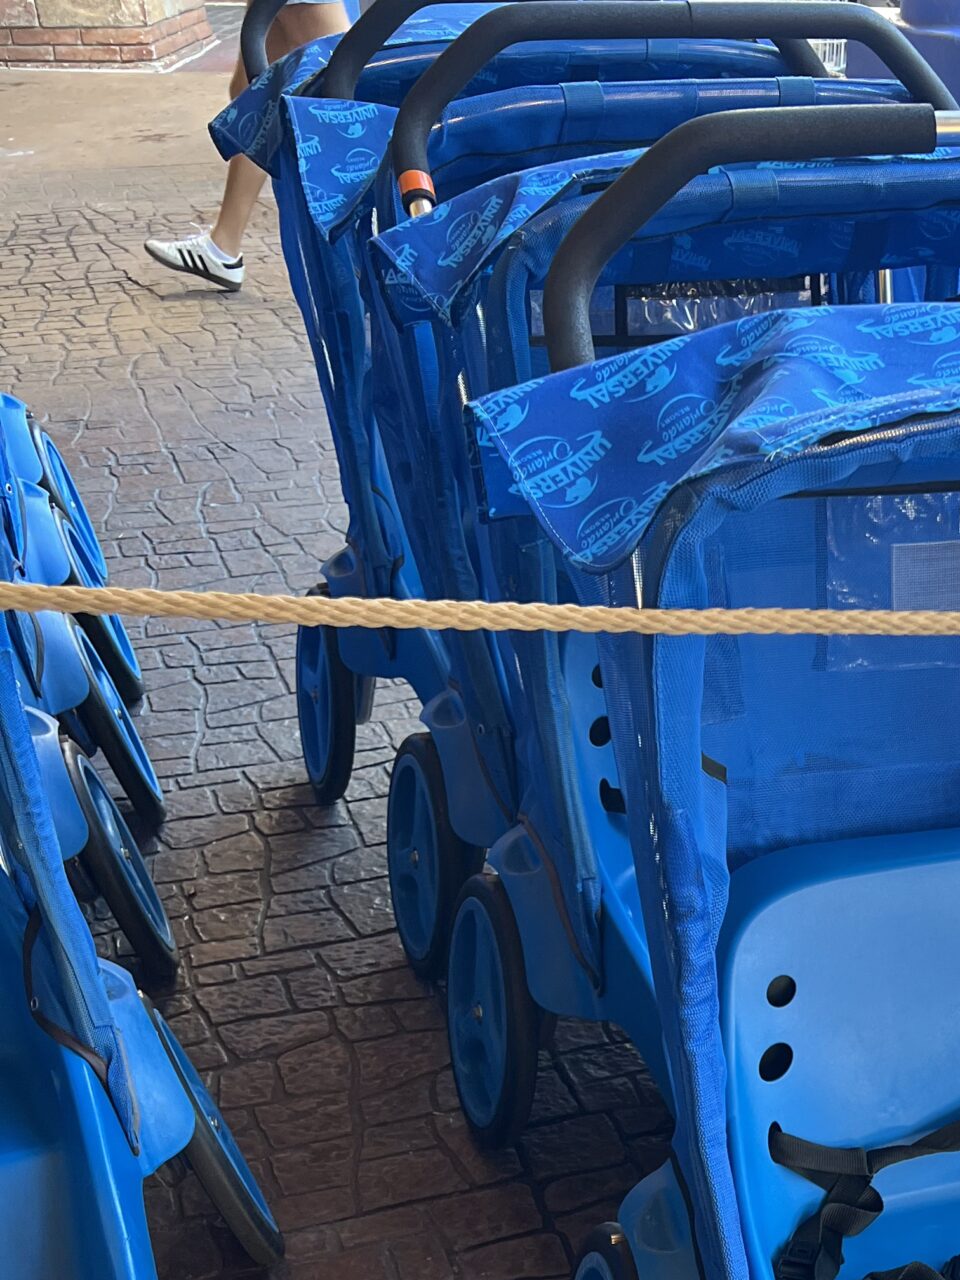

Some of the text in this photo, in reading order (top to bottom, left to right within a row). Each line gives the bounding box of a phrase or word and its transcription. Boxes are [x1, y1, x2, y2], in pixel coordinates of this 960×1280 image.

[584, 335, 692, 409] UNIVERSAL
[661, 399, 717, 443] Orlando
[581, 497, 637, 549] Orlando
